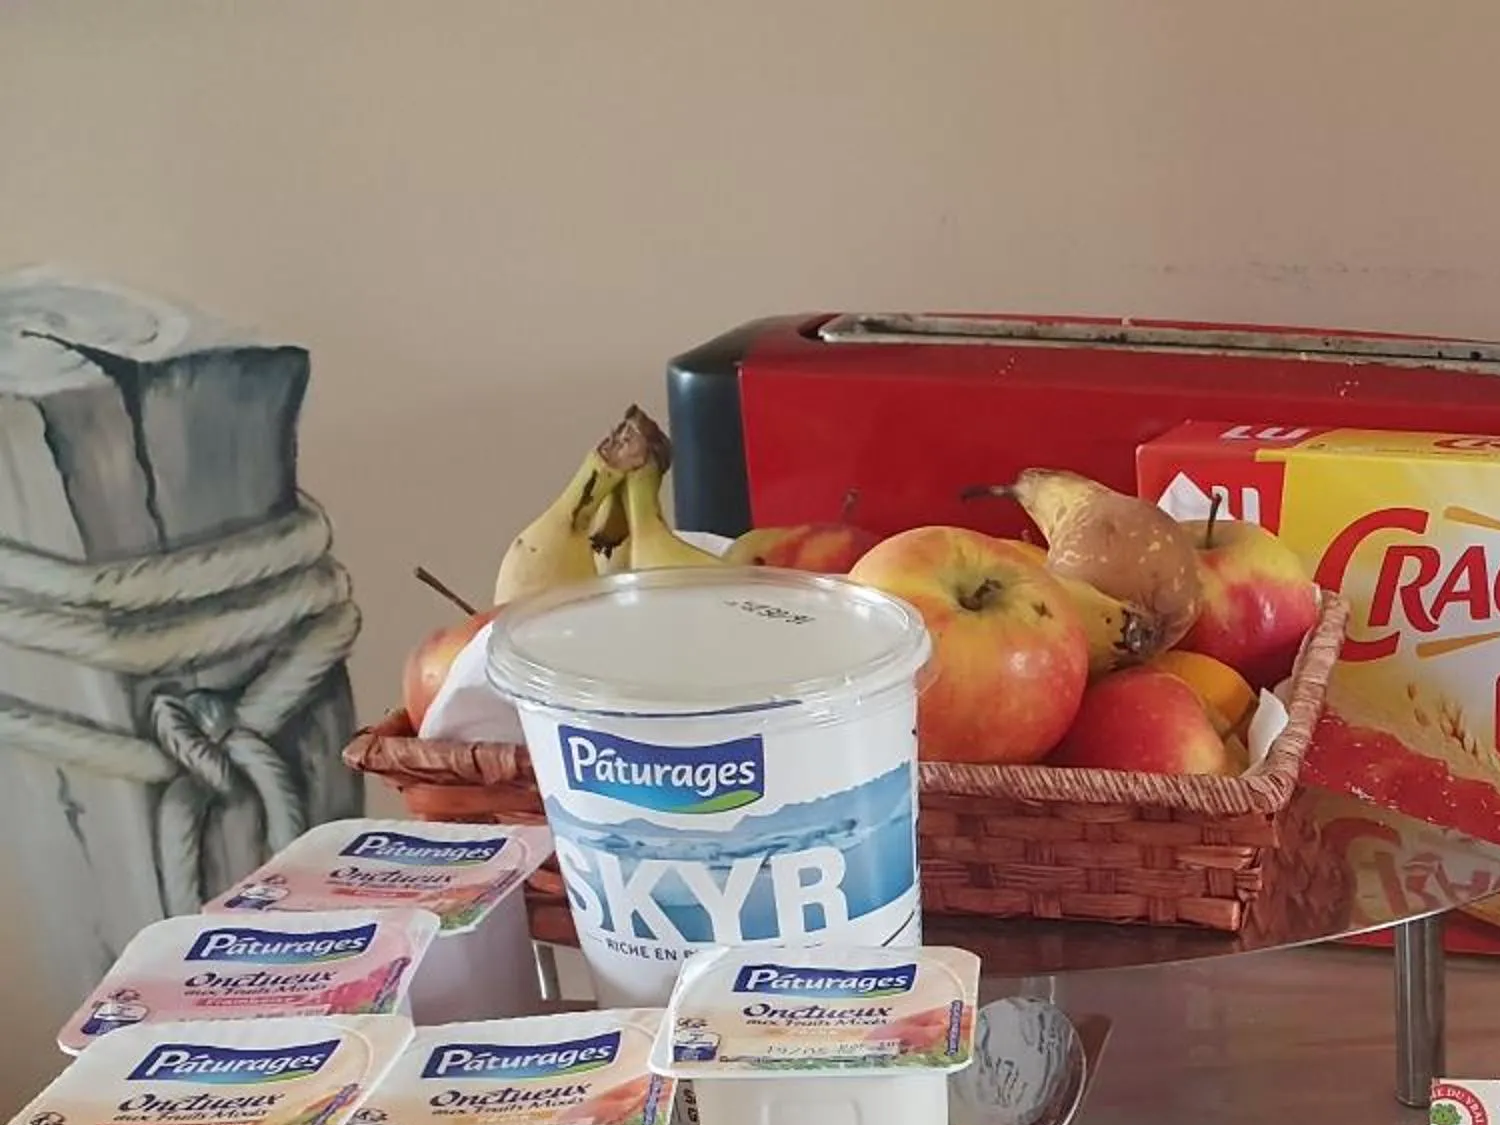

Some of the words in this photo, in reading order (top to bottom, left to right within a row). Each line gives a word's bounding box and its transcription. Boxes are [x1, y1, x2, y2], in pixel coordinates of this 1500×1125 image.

[1219, 425, 1312, 441] LU
[553, 840, 850, 948] SKYR
[607, 938, 650, 959] RICHE
[655, 947, 678, 961] EN
[743, 1003, 894, 1019] Onctueux
[117, 1092, 287, 1112] Onctueux
[430, 1083, 593, 1107] Onctueux
